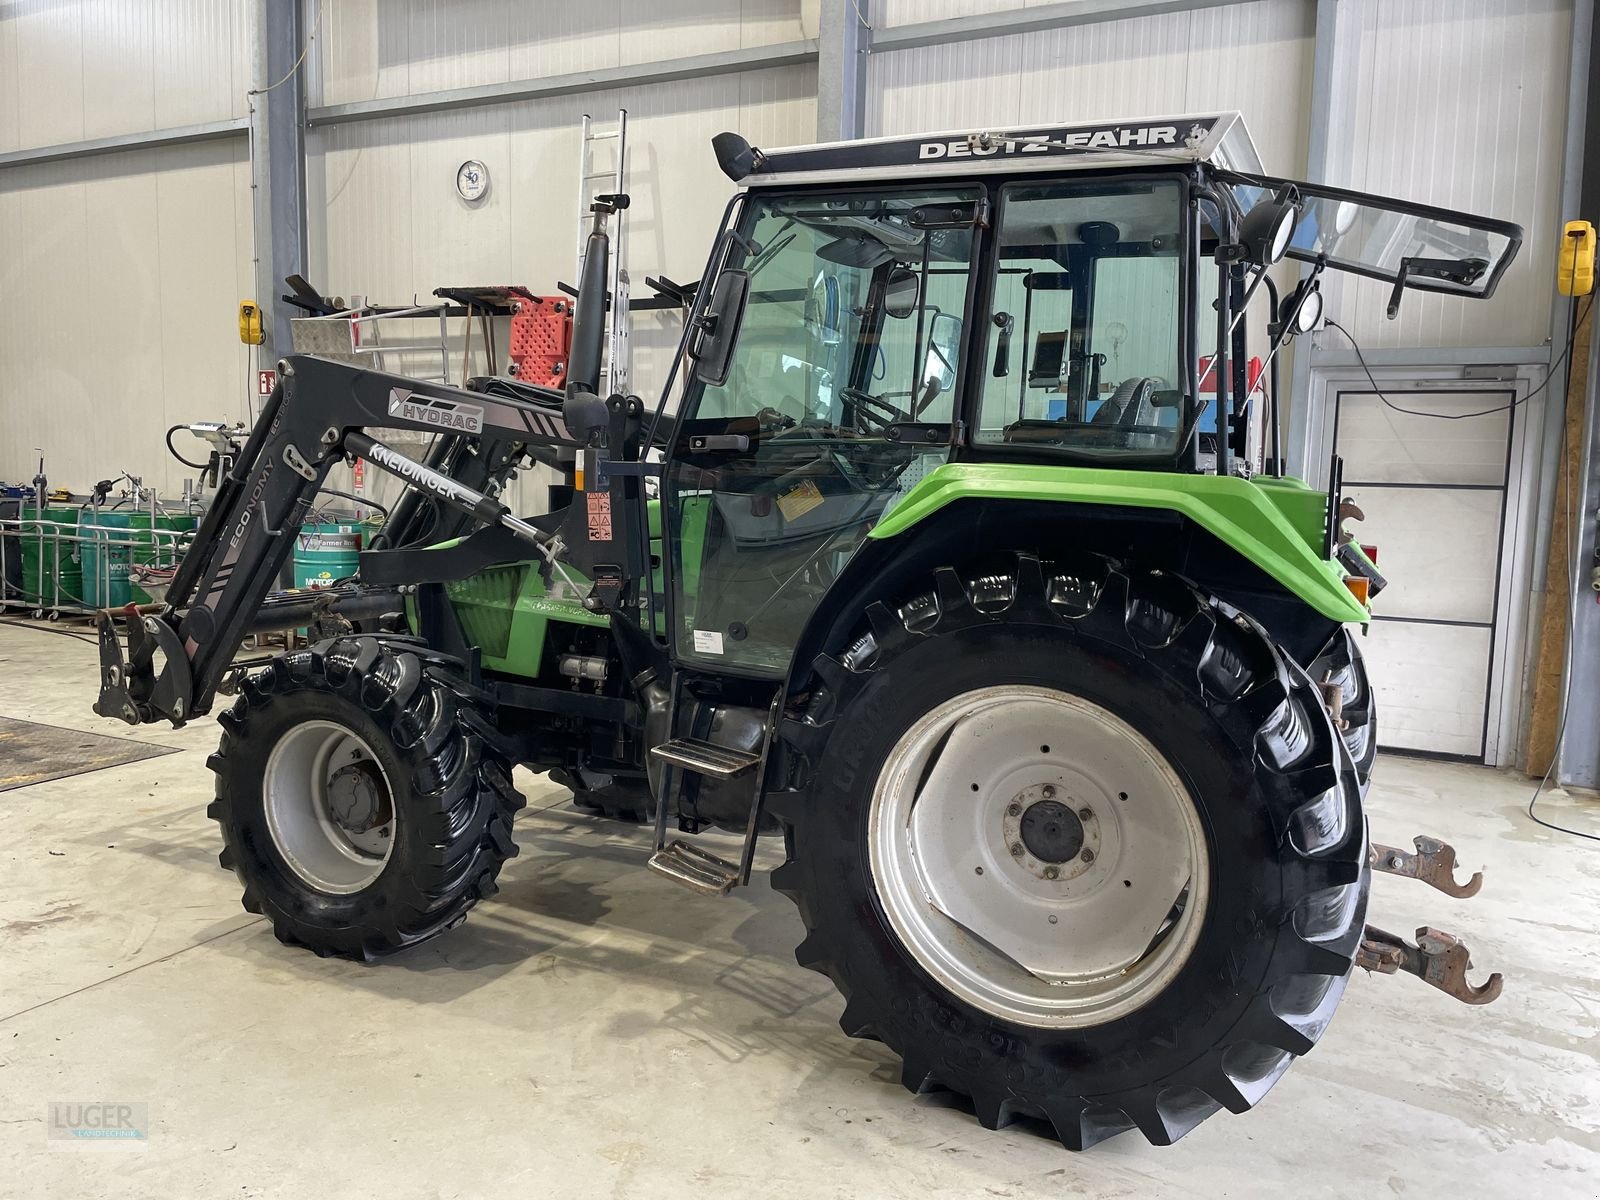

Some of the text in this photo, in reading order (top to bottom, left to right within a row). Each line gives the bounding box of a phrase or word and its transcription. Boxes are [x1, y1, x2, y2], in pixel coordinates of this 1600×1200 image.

[918, 126, 1177, 160] DEUTZ-FAHR
[402, 404, 479, 431] HYDRAC
[368, 442, 457, 500] KNEIDINGER
[229, 457, 274, 549] ECONOMY
